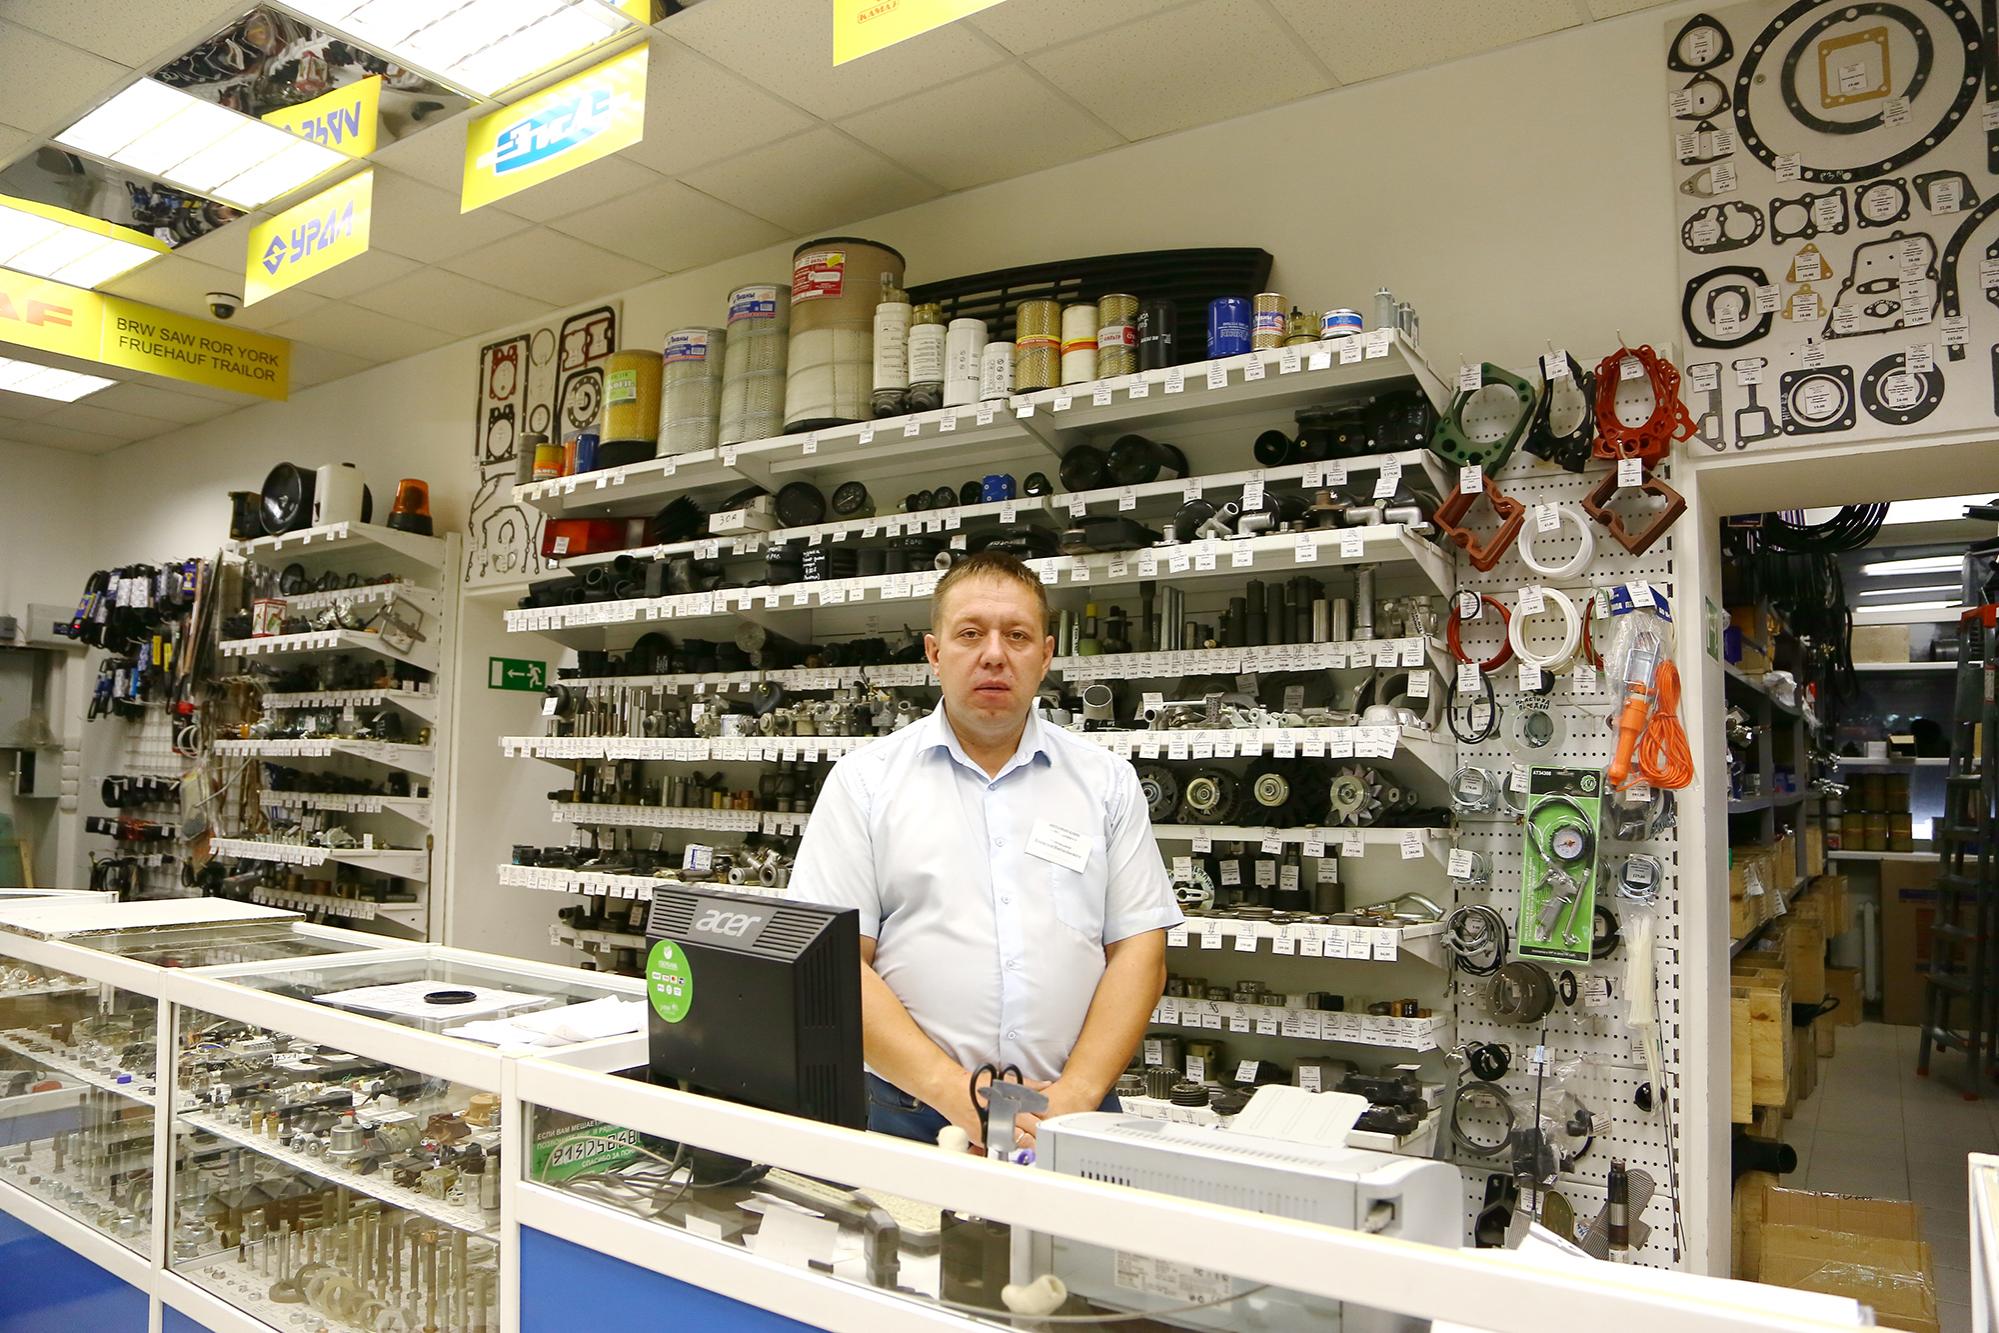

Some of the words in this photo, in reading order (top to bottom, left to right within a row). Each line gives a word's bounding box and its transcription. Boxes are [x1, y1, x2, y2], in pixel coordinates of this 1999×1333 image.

[116, 317, 156, 338] BRW
[159, 328, 196, 347] SAW
[200, 338, 234, 357] ROR
[237, 345, 280, 368] YORK
[118, 335, 207, 366] FRUEHAUF
[211, 356, 277, 383] TRAILOR
[695, 909, 762, 937] acer
[537, 1130, 556, 1141] ЕСЛИ
[556, 1125, 571, 1136] ВАМ
